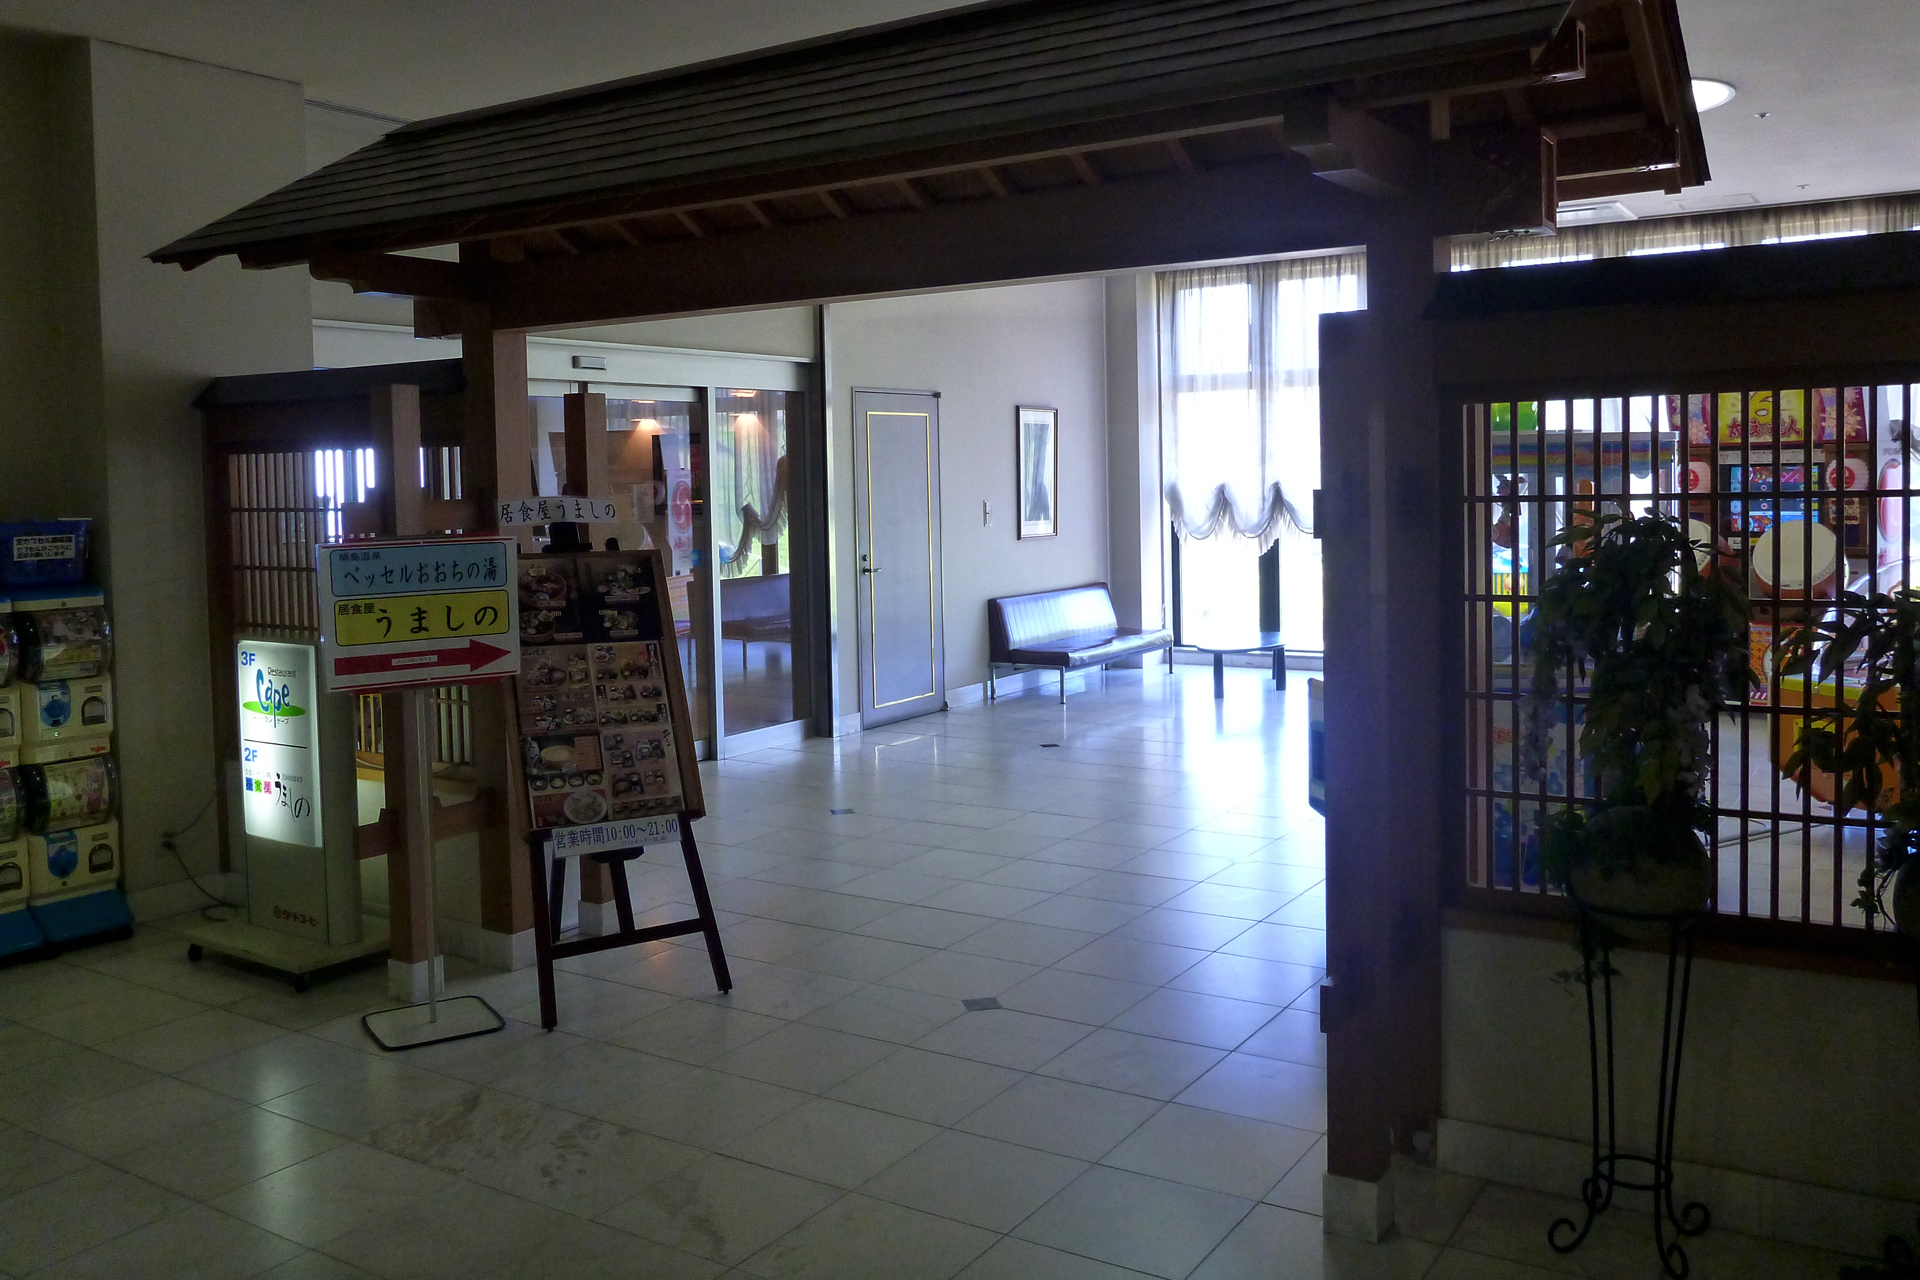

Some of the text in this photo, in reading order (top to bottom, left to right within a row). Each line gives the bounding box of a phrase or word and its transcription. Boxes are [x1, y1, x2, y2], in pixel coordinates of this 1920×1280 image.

[500, 499, 616, 525] 居食屋うましの
[344, 556, 498, 589] ベッセルおおちの湯
[337, 603, 499, 638] 居食屋 うましの
[240, 651, 256, 667] 3F
[267, 667, 297, 679] Restaurant
[256, 668, 290, 729] Cape
[244, 747, 259, 763] 2F
